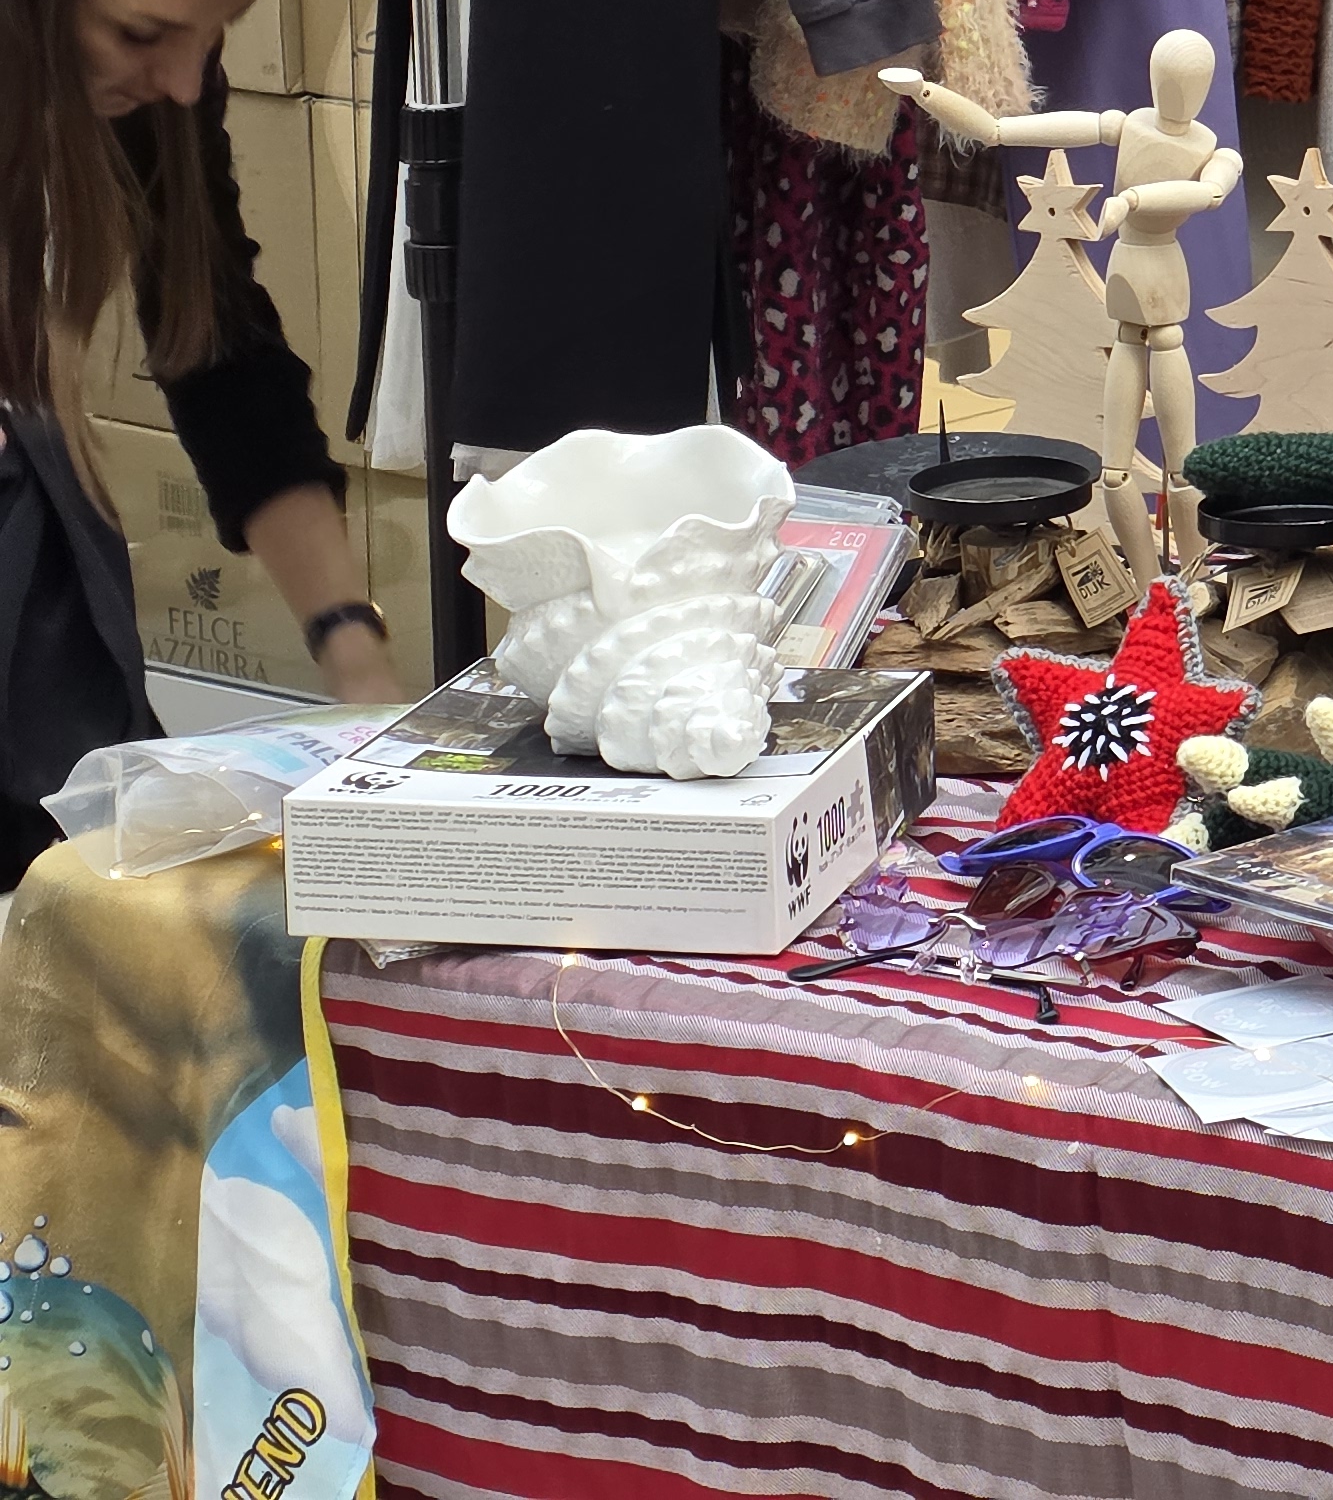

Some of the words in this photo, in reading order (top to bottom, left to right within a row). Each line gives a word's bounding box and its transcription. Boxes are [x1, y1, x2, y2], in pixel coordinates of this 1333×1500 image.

[829, 531, 839, 547] 2
[841, 532, 867, 548] CD
[1078, 576, 1111, 601] DIJK
[168, 607, 246, 651] FELCE
[149, 637, 272, 685] AZZURRA
[489, 783, 592, 798] 1000
[816, 796, 847, 858] 1000
[788, 884, 812, 921] WWF
